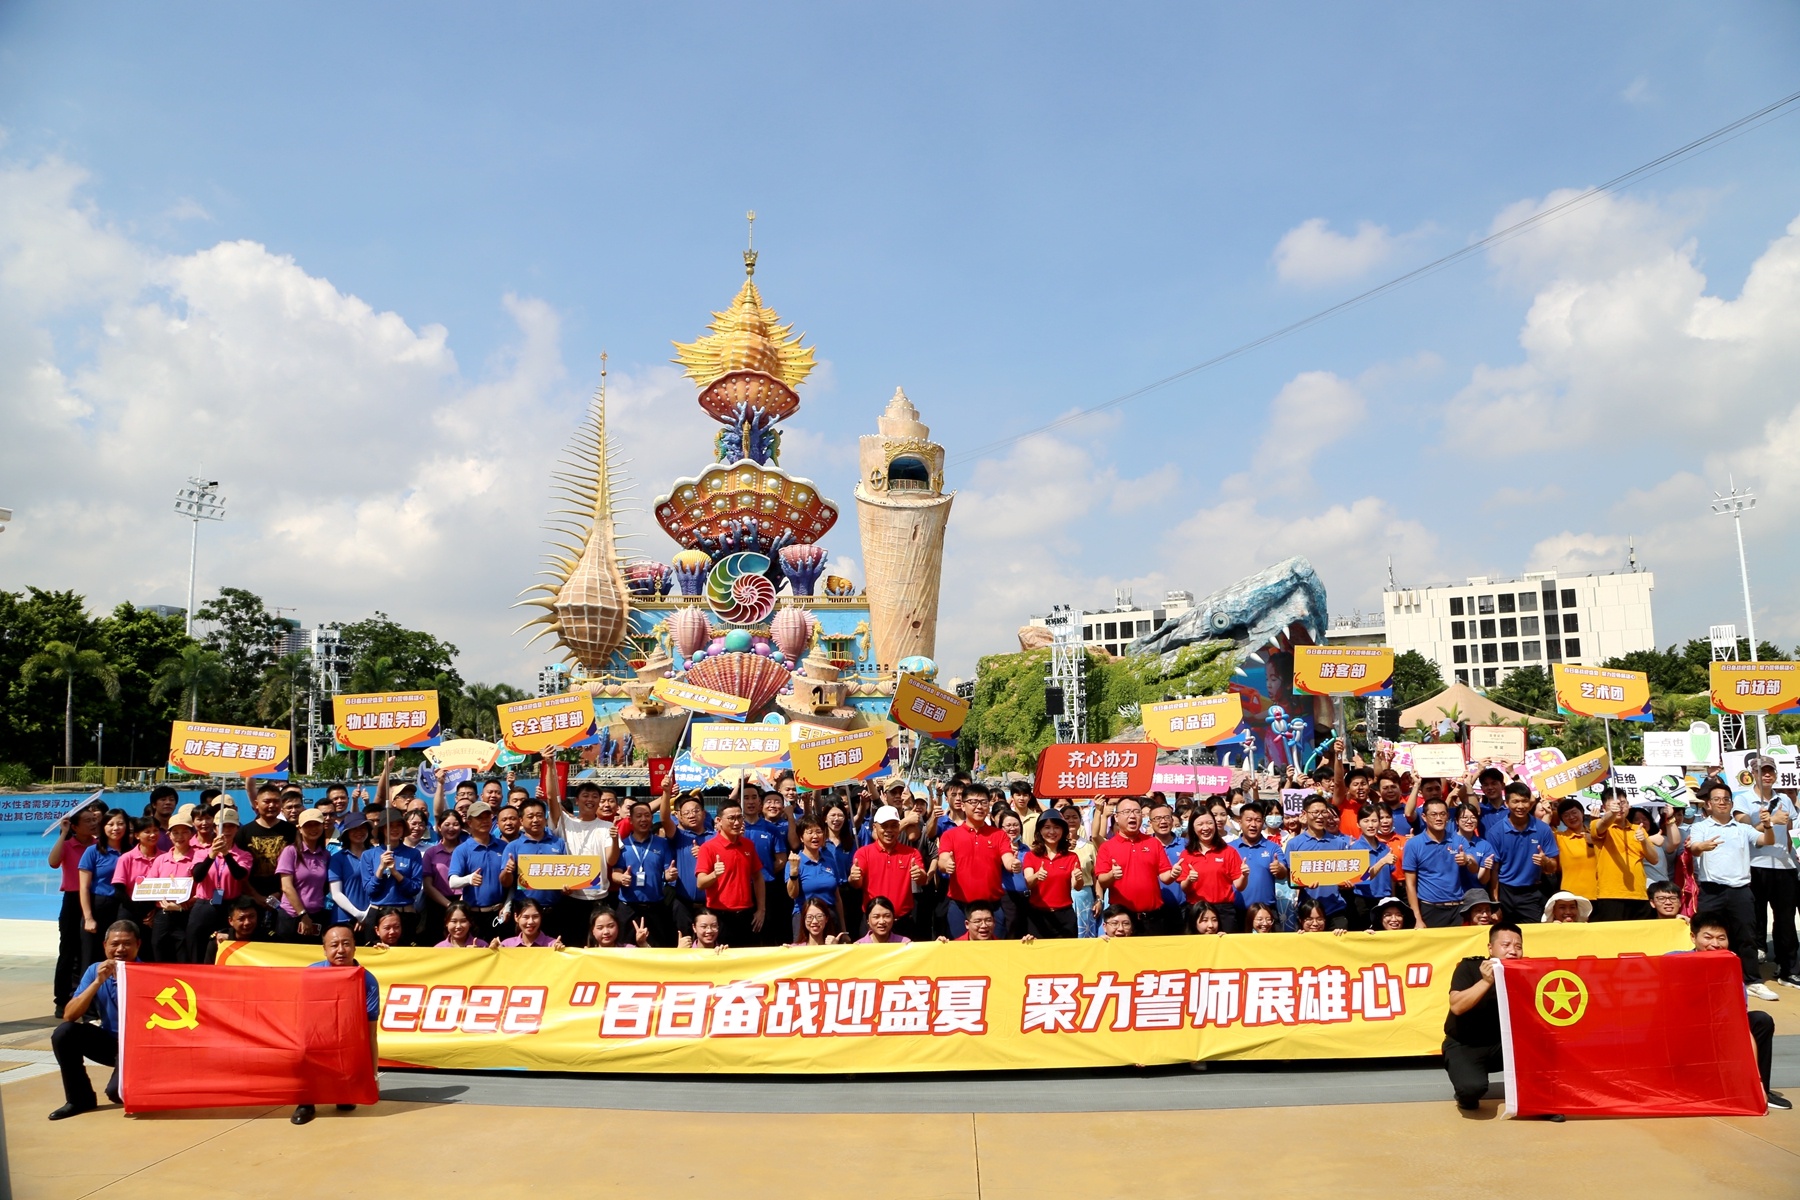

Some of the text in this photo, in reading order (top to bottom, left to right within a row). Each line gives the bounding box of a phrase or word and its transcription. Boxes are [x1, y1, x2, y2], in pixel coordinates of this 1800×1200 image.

[1320, 662, 1366, 679] 游客部
[1580, 682, 1624, 701] 艺术团
[1736, 679, 1781, 696] 市场部
[911, 696, 948, 723] 营运部
[346, 710, 427, 731] 物业服务部
[511, 709, 584, 738] 安全管理部
[1170, 712, 1216, 733] 商品部
[183, 739, 276, 760] 财务管理部
[702, 737, 780, 752] 酒店公寓部
[1648, 738, 1684, 747] 一点也
[818, 747, 863, 771] 招商部
[1067, 750, 1138, 768] 齐心协力
[1649, 749, 1684, 758] 不辛苦
[1057, 771, 1129, 789] 共创佳绩
[1544, 758, 1603, 790] 最佳风采奖
[1, 799, 80, 810] 水性者需穿浮力衣
[0, 811, 69, 822] 出其它危险动
[527, 863, 592, 877] 最具活力奖
[1300, 859, 1361, 873] 最佳创意奖
[380, 983, 548, 1034] 2022
